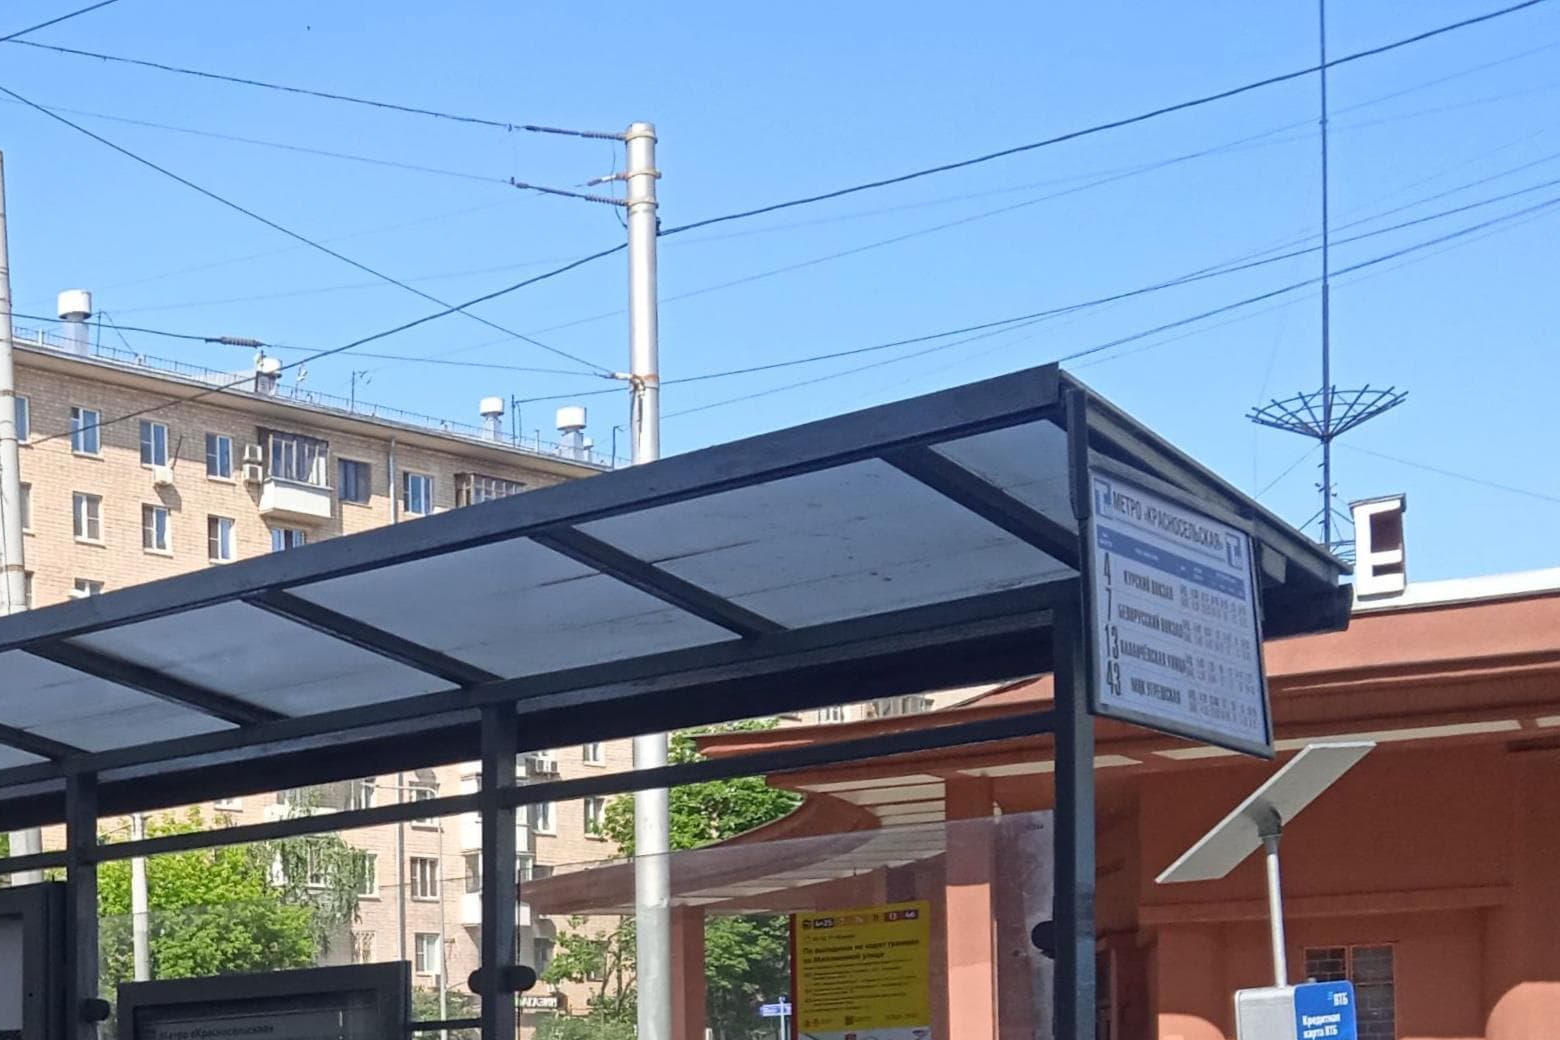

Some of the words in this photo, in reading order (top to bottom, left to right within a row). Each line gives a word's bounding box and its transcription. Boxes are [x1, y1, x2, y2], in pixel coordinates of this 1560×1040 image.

[1113, 489, 1141, 521] МЕТРО
[1103, 552, 1111, 585] 4
[1105, 588, 1112, 621] 7
[1105, 624, 1120, 660] 13
[1106, 662, 1121, 697] 43
